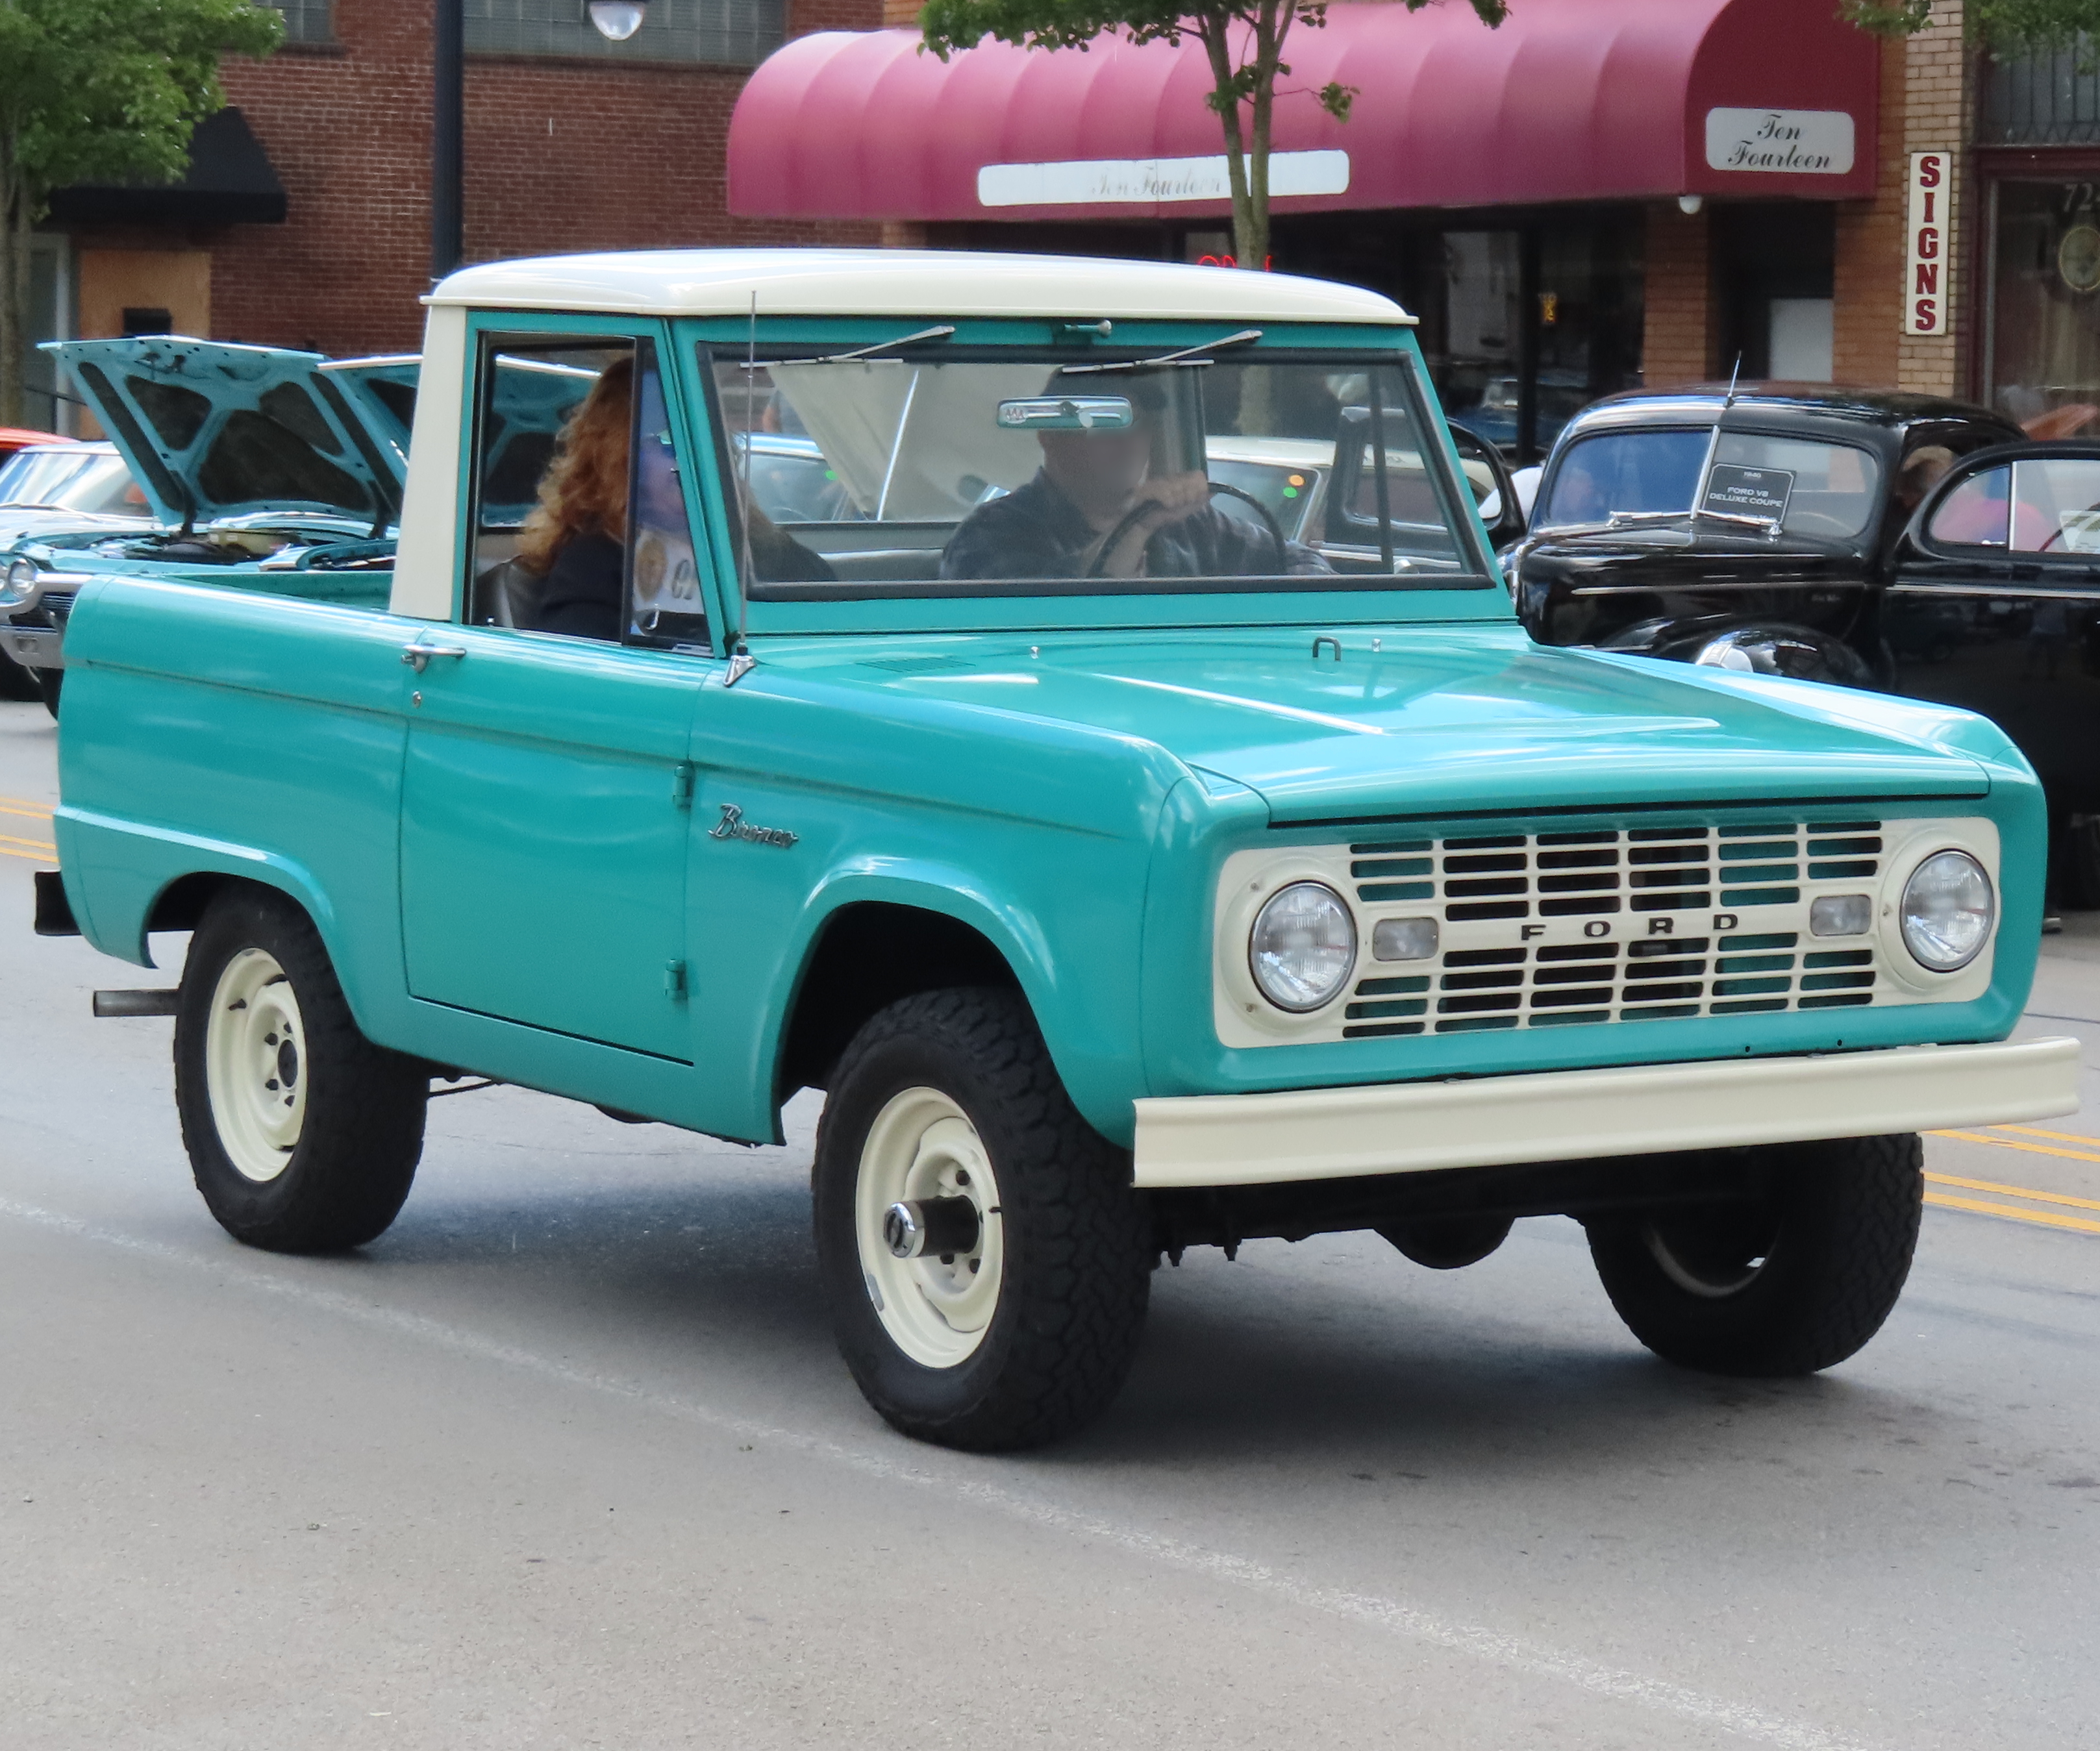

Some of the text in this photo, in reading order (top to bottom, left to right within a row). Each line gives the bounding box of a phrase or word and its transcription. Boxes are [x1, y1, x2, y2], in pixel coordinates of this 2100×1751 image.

[1756, 114, 1801, 140] Ten
[1727, 140, 1831, 169] Fourteen
[2064, 182, 2099, 213] 72
[1915, 156, 1940, 330] SIGNS
[1709, 492, 1784, 508] DELUXE COUPE
[1727, 486, 1769, 498] FORD V8
[708, 802, 799, 849] Bronco
[1521, 913, 1738, 941] FORD
